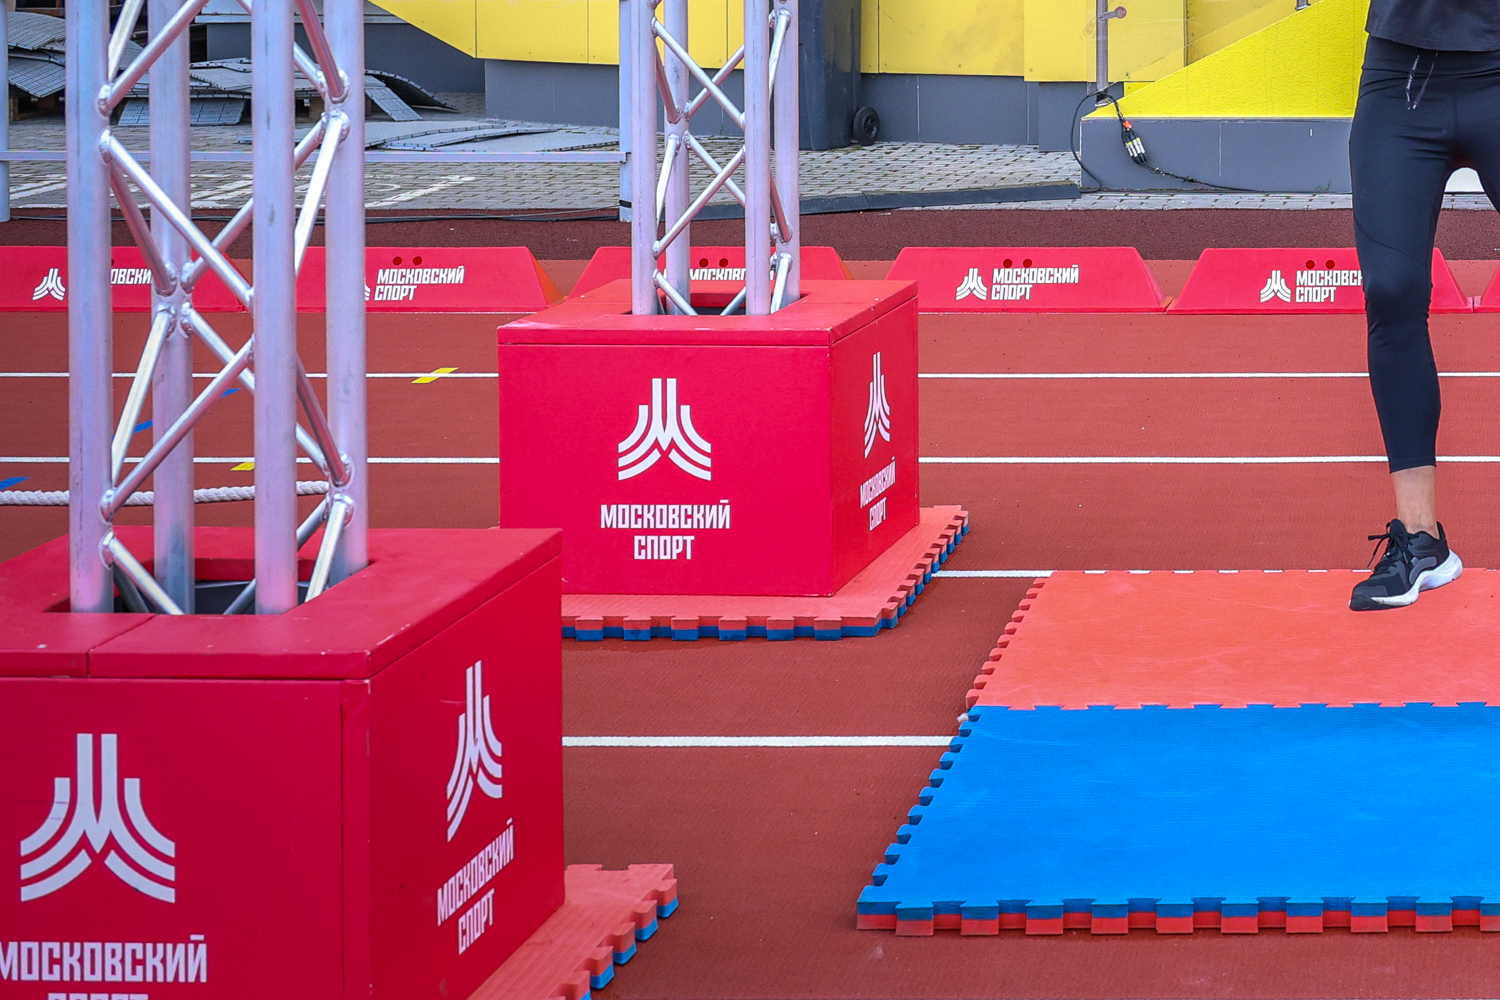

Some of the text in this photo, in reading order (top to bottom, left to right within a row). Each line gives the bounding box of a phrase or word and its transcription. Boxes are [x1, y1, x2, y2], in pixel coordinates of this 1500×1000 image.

[376, 265, 465, 284] МОСКОВСКИЙ
[992, 264, 1079, 284] МОСКОВСКИЙ
[1296, 270, 1363, 286] МОСКОВС
[374, 285, 417, 301] СПОРТ
[991, 284, 1033, 300] СПОРТ
[1295, 286, 1337, 303] СПОРТ
[859, 456, 897, 509] МОСКОВСКИЙ
[600, 499, 731, 529] МОСКОВСКИЙ
[868, 497, 887, 531] СПОРТ
[633, 535, 695, 560] СПОРТ
[436, 817, 515, 927] МОСКОВСКИЙ
[457, 888, 495, 956] СПОРТ
[0, 934, 208, 983] МОСКОВСКИЙ
